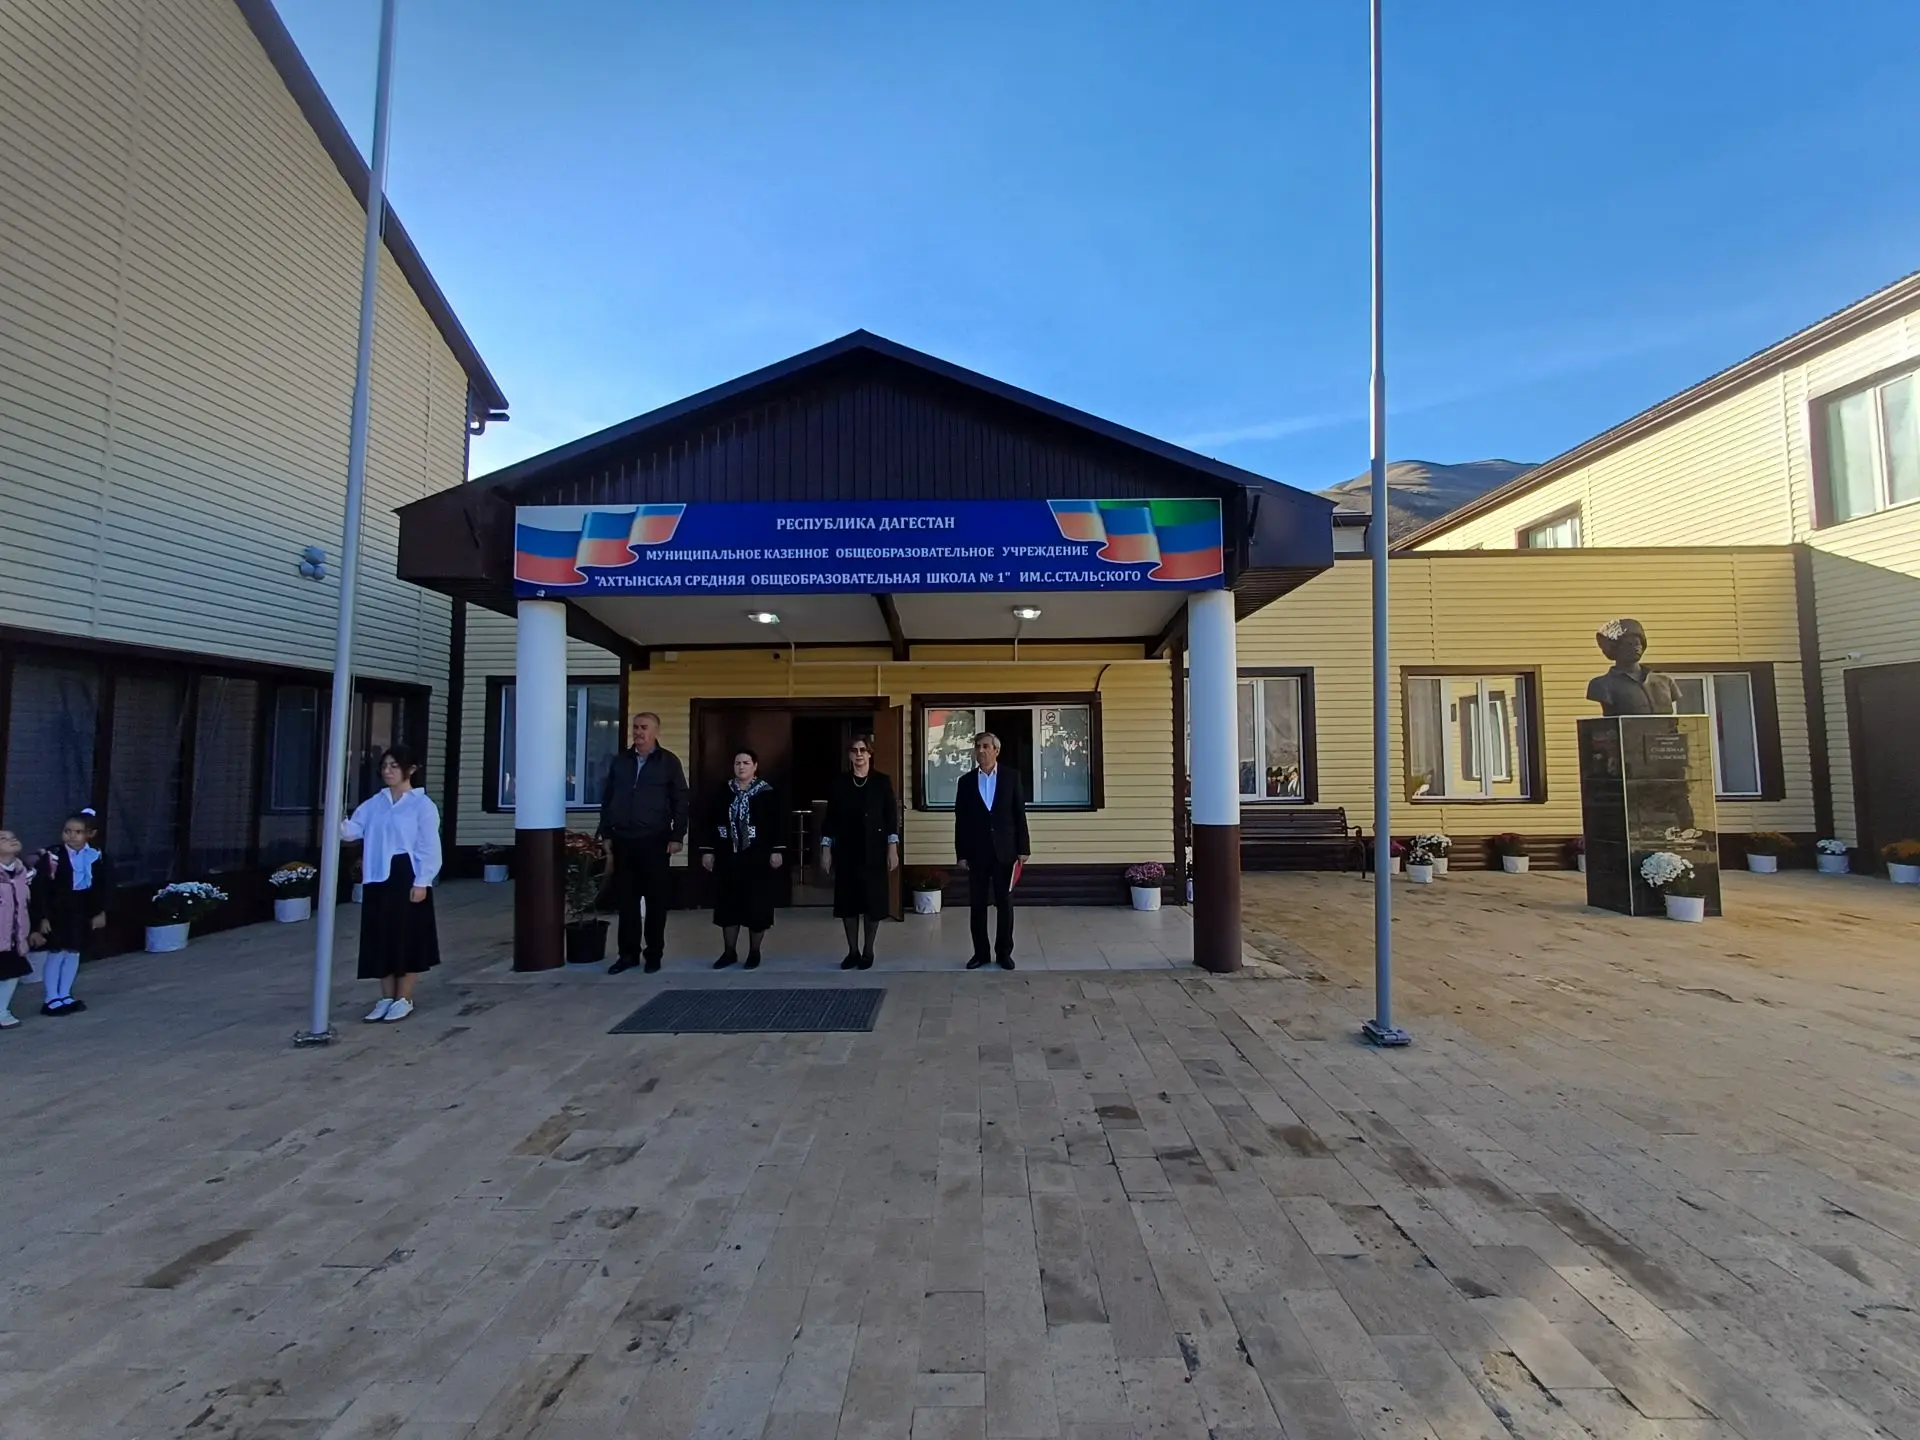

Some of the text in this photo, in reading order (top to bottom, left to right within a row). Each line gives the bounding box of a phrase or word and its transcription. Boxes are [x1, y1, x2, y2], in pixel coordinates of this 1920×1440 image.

[776, 516, 955, 532] РЕСПУБЛИКА ДАГЕСТАН
[646, 546, 1089, 561] МУНИЦИПАЛЬНОЕ КАЗЕННОЕ ОБЩЕОБРАЗОВАТЕЛЬНОЕ УЧРЕЖДЕНИЕ
[594, 575, 681, 587] "АХТЫНСКАЯ
[685, 575, 746, 588] СРЕДНЯЯ
[751, 573, 921, 587] ОБЩЕОБРАЗОВАТЕЛЬНАЯ
[926, 572, 976, 584] ШКОЛА
[1019, 570, 1141, 583] ИМ.С.СТАЛЬСКОГО
